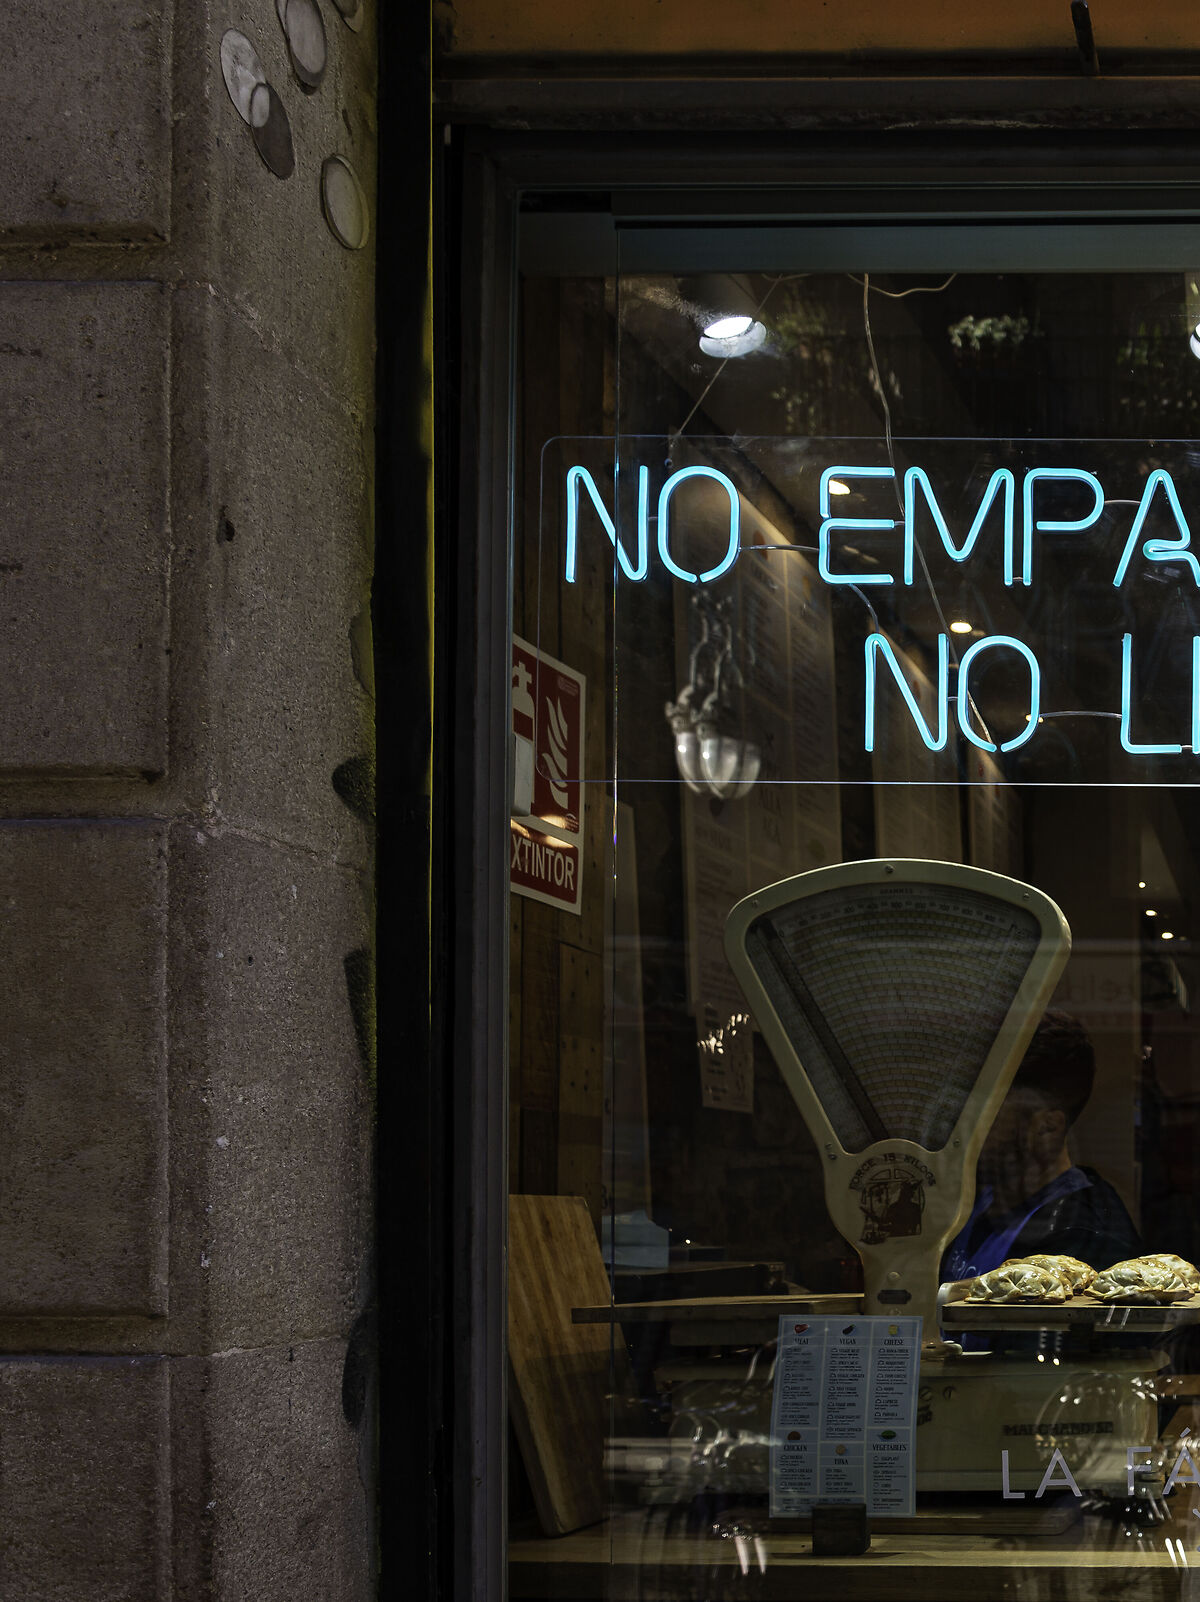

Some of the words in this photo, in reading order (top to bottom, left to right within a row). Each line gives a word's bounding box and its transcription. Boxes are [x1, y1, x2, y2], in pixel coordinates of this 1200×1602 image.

[564, 466, 742, 585] NO
[864, 633, 1041, 754] NO
[511, 834, 574, 891] XTINTOR
[1001, 1447, 1083, 1500] LA
